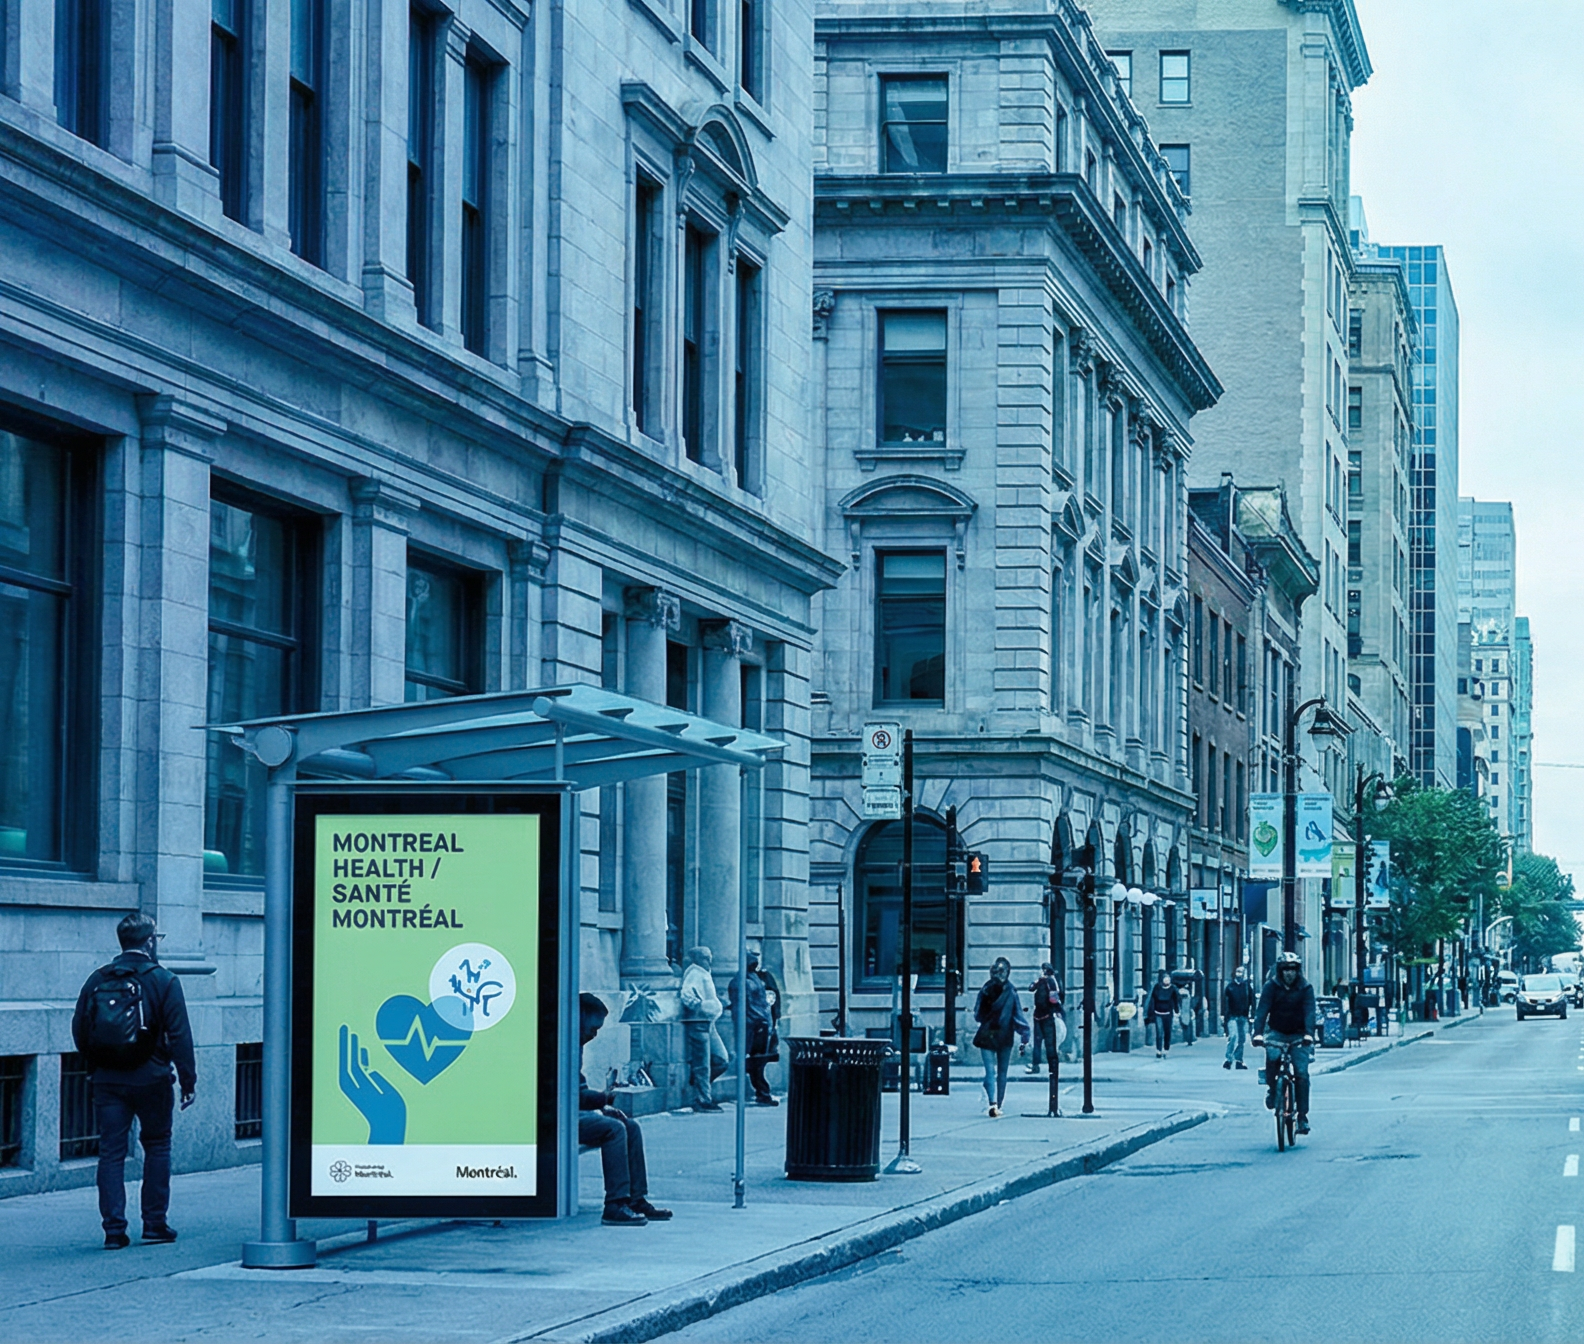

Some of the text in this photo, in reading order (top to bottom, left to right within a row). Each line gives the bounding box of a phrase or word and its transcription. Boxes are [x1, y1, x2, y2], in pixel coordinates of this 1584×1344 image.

[332, 832, 465, 854] MONTREAL
[333, 856, 442, 880] HEALTH /
[332, 879, 412, 904] SANTÉ
[332, 904, 464, 929] MONTRÉAL
